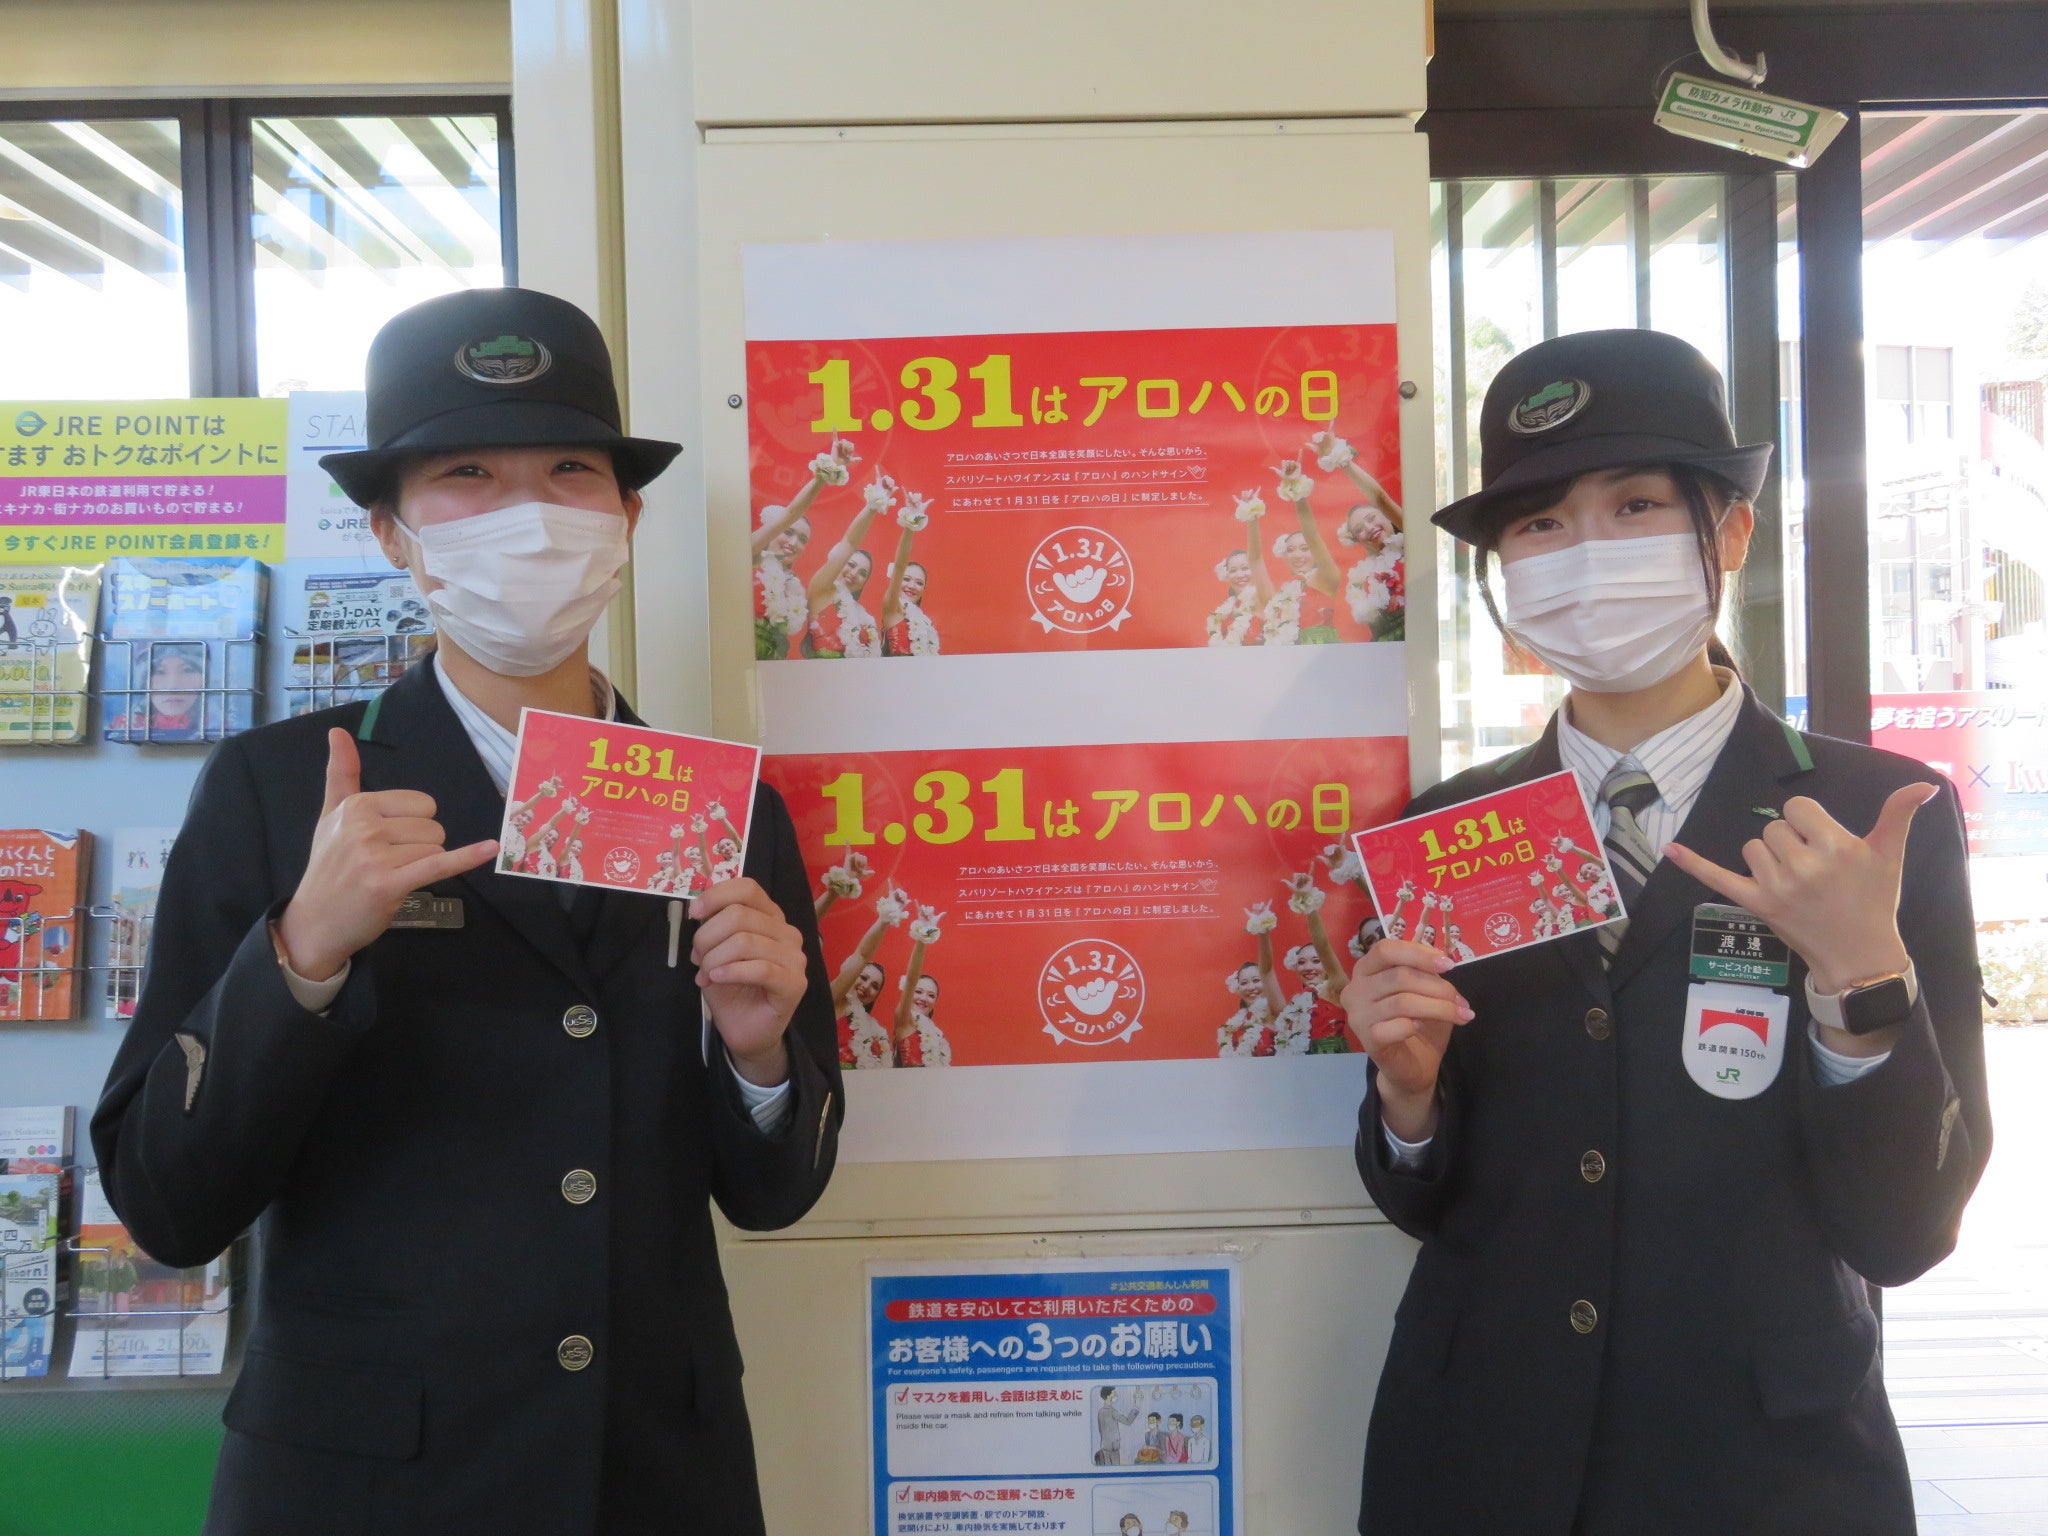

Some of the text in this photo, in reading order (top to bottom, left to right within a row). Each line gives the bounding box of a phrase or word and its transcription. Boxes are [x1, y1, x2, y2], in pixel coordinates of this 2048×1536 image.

[1688, 86, 1774, 116] 防犯カメラ作動中
[1711, 113, 1741, 127] System
[1753, 124, 1795, 140] Operation
[808, 354, 1339, 434] 1.31はアロハの日
[53, 414, 226, 437] JRE POINTは
[306, 414, 368, 439] STA
[0, 443, 279, 467] ます おトクなポイントに
[5, 535, 96, 551] 今すぐJRE
[1052, 538, 1105, 563] 1.31
[1047, 598, 1116, 624] アロハの日
[307, 618, 382, 631] 定期観光バス
[586, 737, 694, 783] 1.31は
[580, 775, 690, 813] アロハの日
[821, 767, 1350, 846] 1.31はアロハの日
[1418, 810, 1527, 862] 1.31は
[1427, 839, 1536, 889] アロハの日
[1063, 950, 1117, 975] 1.31
[1717, 948, 1764, 959] WATANABE
[1708, 960, 1773, 977] サービス介助士
[1058, 1011, 1127, 1035] アロハの日
[1716, 1067, 1742, 1082] JR
[908, 1297, 1194, 1319] 鉄道を安心してご利用いただくための
[888, 1320, 1213, 1363] お客様への3つのお願い
[887, 1368, 902, 1376] For
[903, 1366, 947, 1376] everyone's
[949, 1366, 976, 1376] safety,
[977, 1366, 1023, 1375] passengers
[1040, 1364, 1081, 1373] requested
[1082, 1364, 1091, 1372] to
[1093, 1363, 1110, 1371] take
[1127, 1362, 1164, 1371] following
[1165, 1361, 1216, 1371] precautions.
[912, 1389, 1084, 1404] マスクを着用し、会話は控えめに
[896, 1412, 922, 1420] Please
[950, 1411, 971, 1419] mask
[989, 1410, 1014, 1418] refrain
[1015, 1410, 1033, 1418] from
[1035, 1409, 1060, 1419] talking
[1062, 1409, 1082, 1417] while
